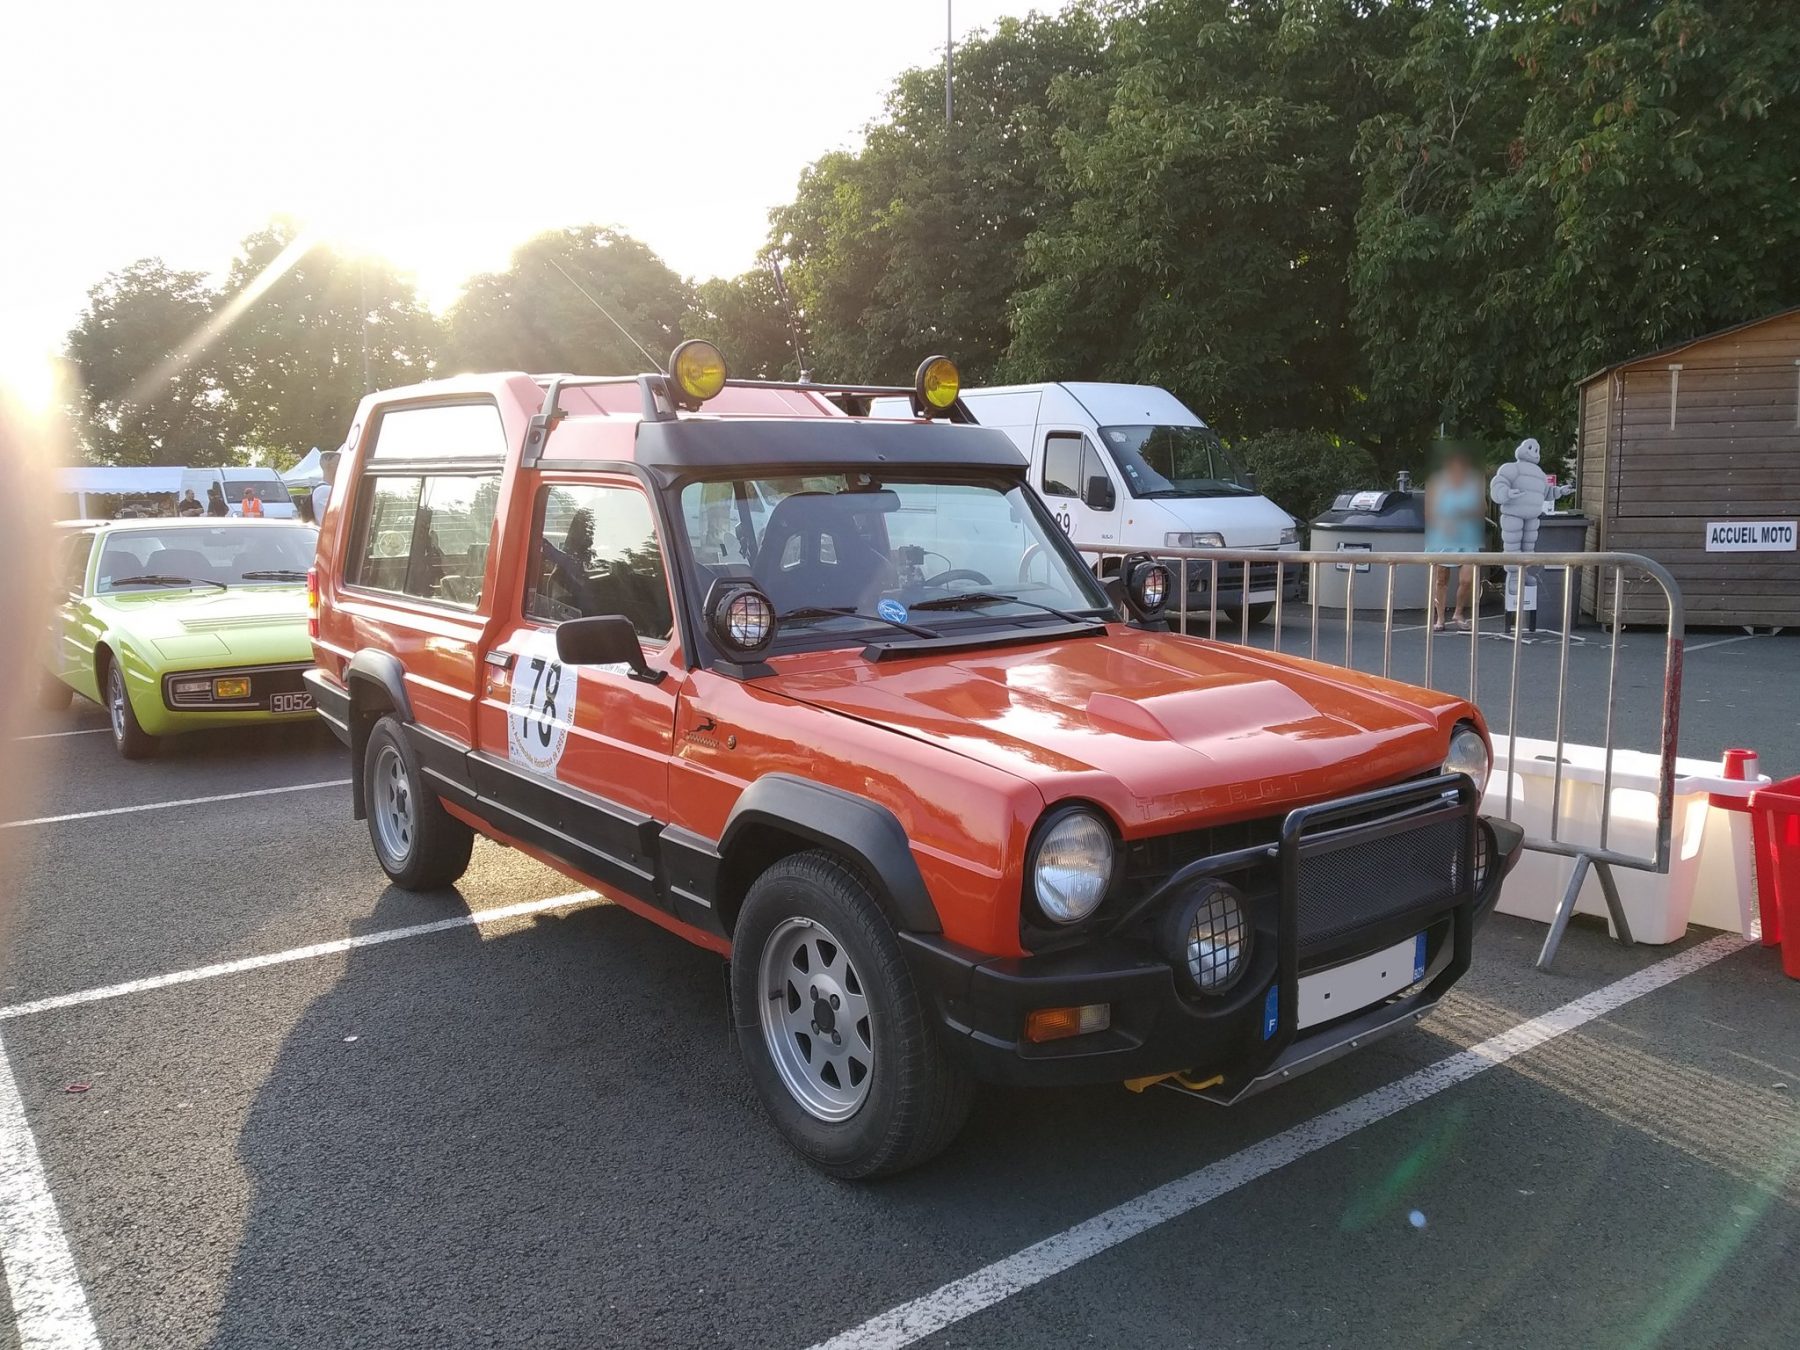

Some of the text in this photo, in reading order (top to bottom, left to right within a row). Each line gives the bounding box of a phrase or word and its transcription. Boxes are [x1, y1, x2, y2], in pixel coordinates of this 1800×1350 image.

[1711, 526, 1792, 543] ACCUEIL MOTO
[274, 693, 313, 712] 9052
[523, 655, 562, 748] 78
[1413, 966, 1425, 980] BZH
[1269, 1018, 1276, 1032] F
